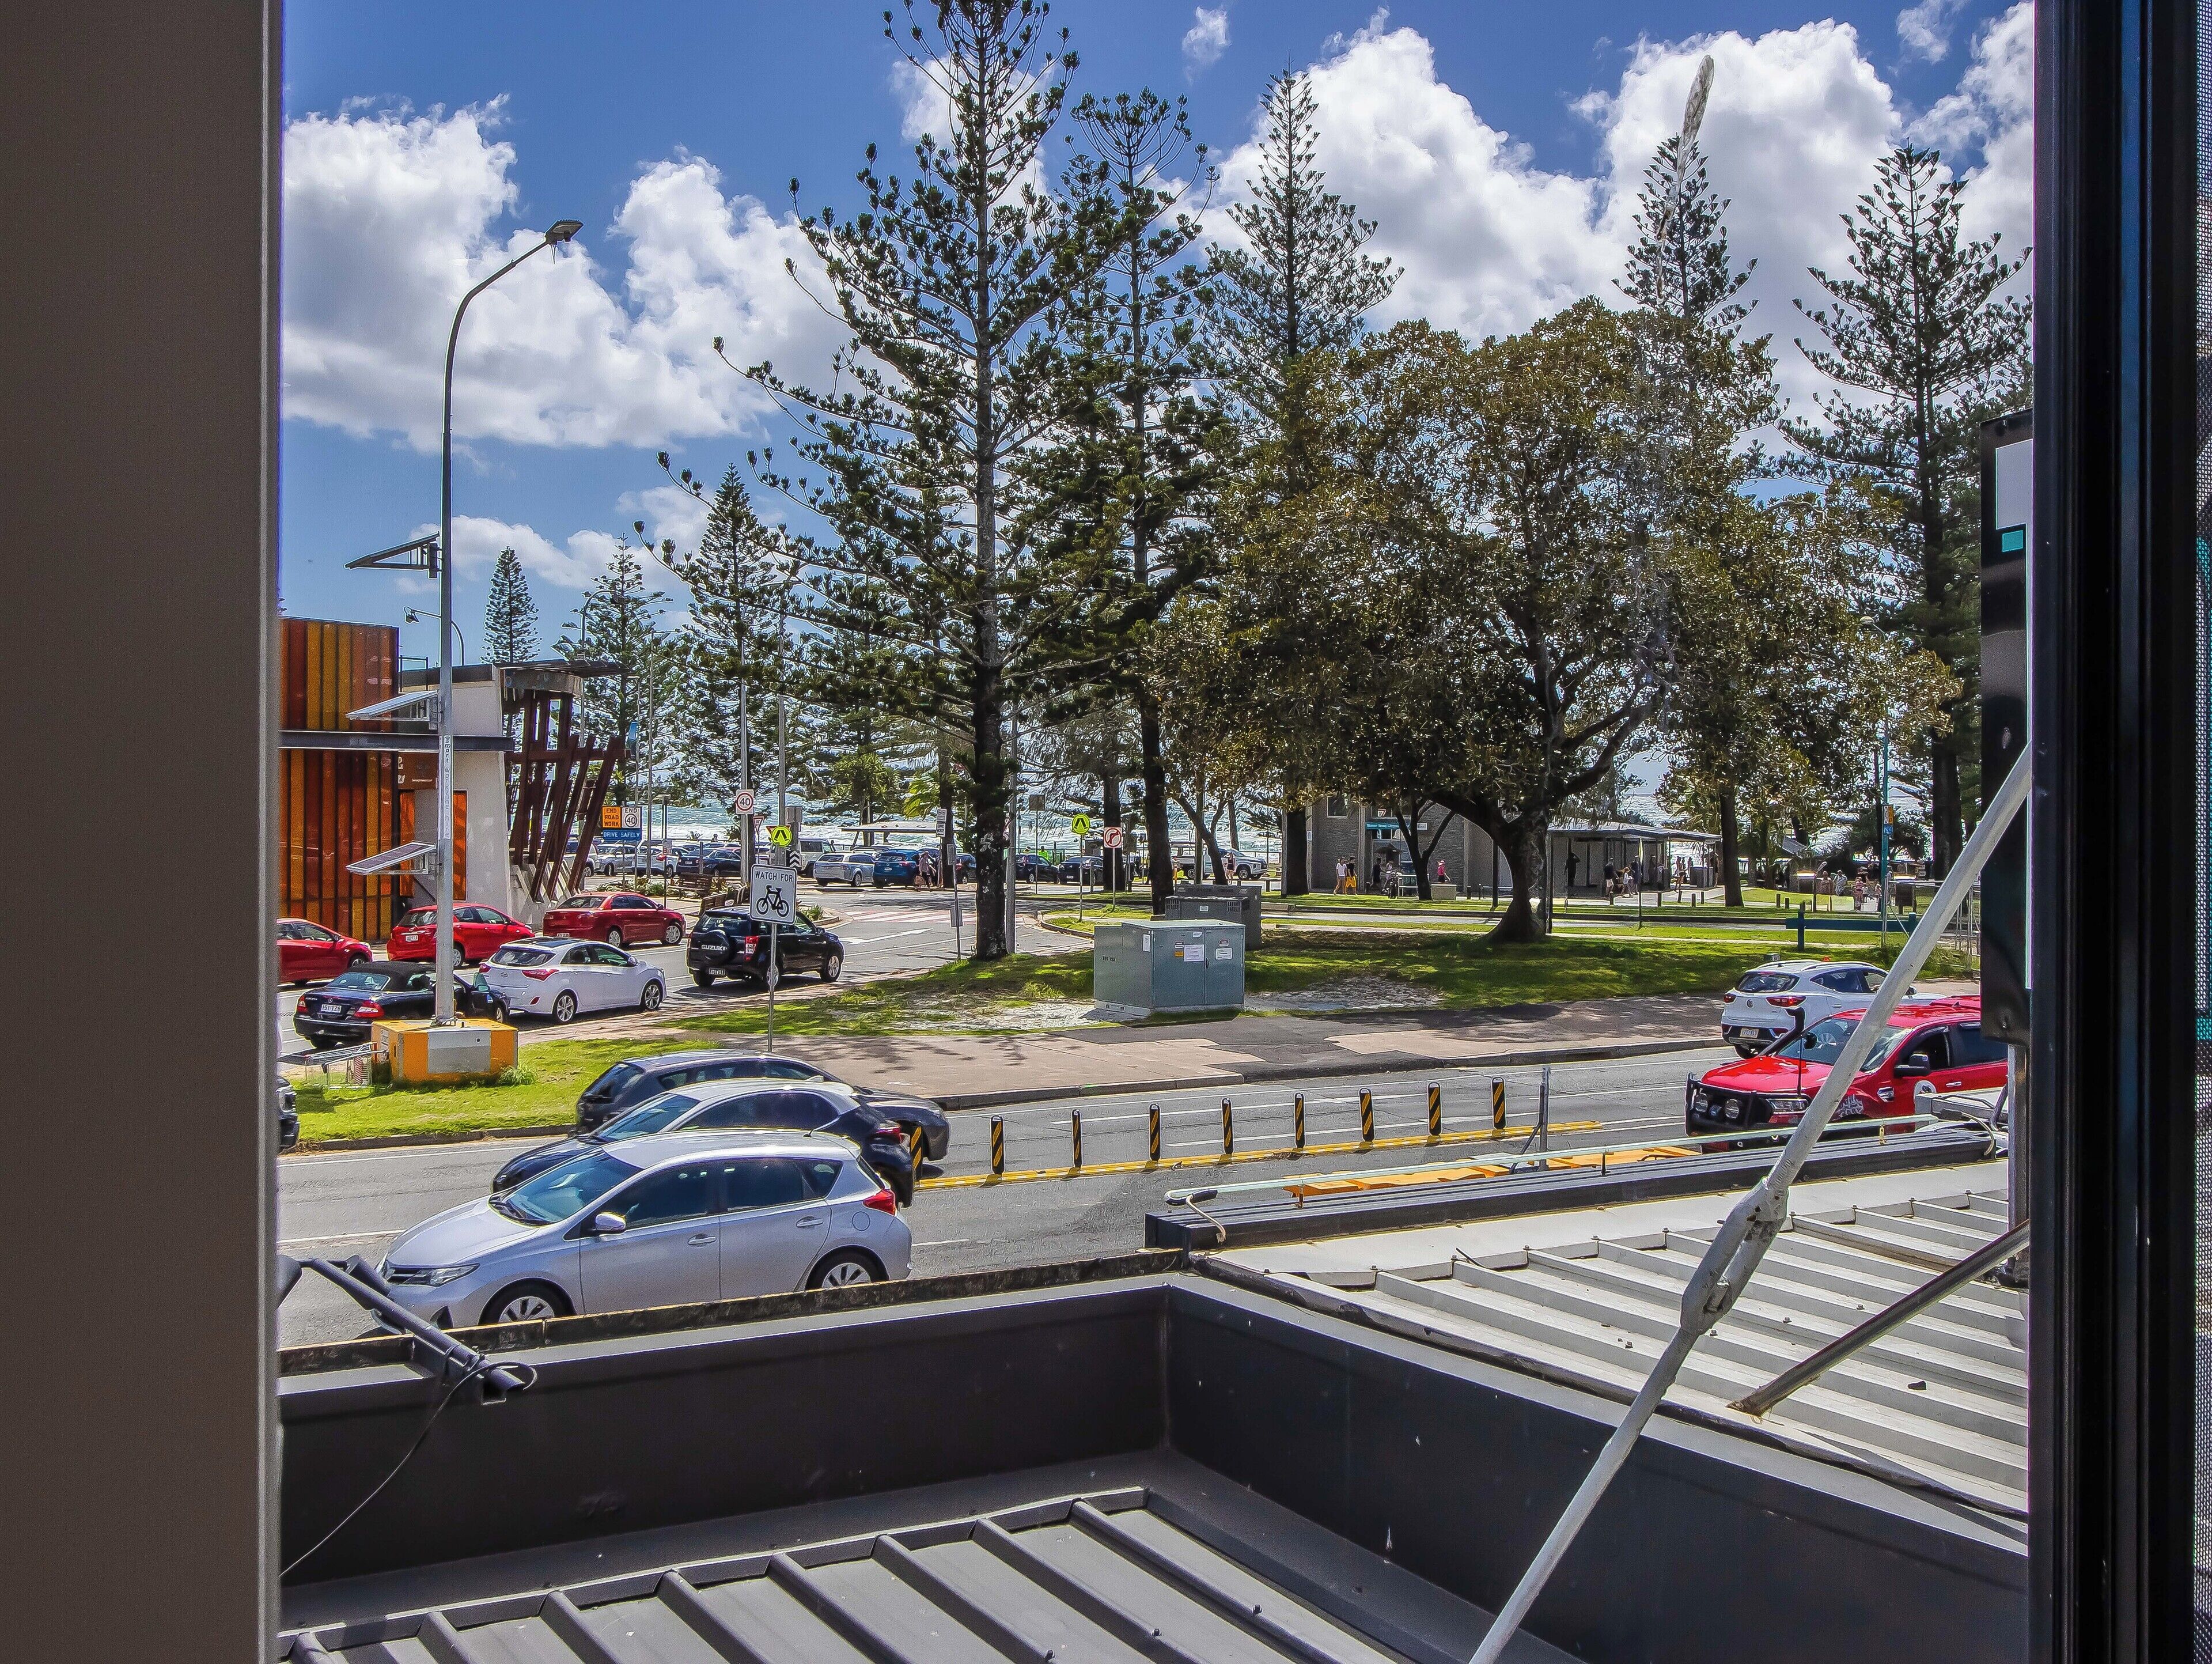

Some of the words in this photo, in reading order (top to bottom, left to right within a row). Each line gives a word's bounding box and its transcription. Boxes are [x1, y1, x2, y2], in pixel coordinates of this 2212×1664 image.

[739, 797, 751, 806] 40
[755, 871, 777, 880] WATCH
[781, 873, 793, 883] FOR
